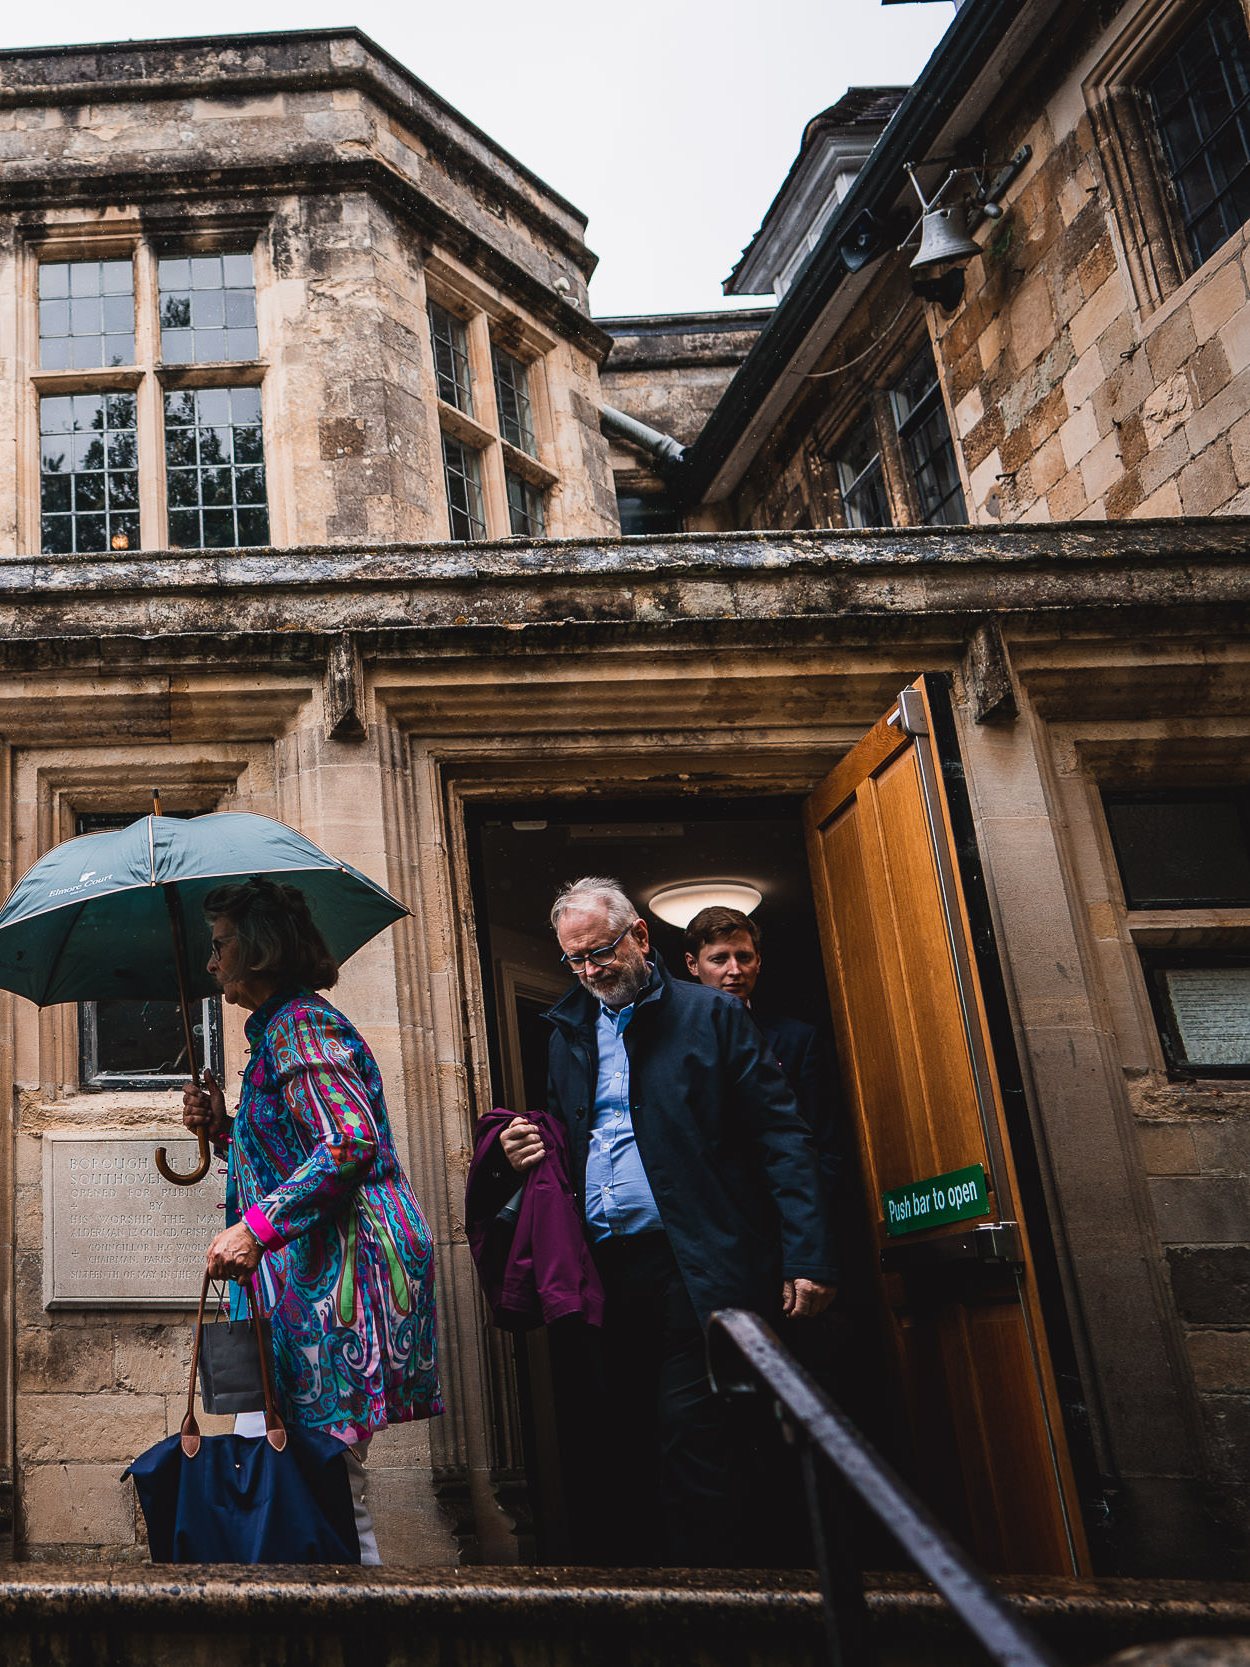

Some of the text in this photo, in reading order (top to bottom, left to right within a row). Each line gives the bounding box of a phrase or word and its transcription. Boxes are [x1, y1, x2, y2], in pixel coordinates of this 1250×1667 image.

[48, 884, 82, 897] Elmore
[84, 873, 113, 887] Court
[70, 1157, 148, 1170] BOROUGH
[70, 1188, 117, 1198] OPENED
[128, 1188, 150, 1198] FOR
[161, 1188, 206, 1197] PUBLIC
[149, 1201, 163, 1211] BY
[888, 1181, 978, 1223] Push bar to open
[70, 1214, 225, 1225] HIS WORSHIP THE MAY
[70, 1227, 124, 1237] ALDERMAN
[88, 1243, 150, 1252] COUNCILLOR
[144, 1255, 171, 1265] PARKS
[70, 1270, 120, 1279] SIXTEENTH
[123, 1270, 136, 1279] OF
[138, 1270, 157, 1279] MAY
[172, 1270, 191, 1279] THE
